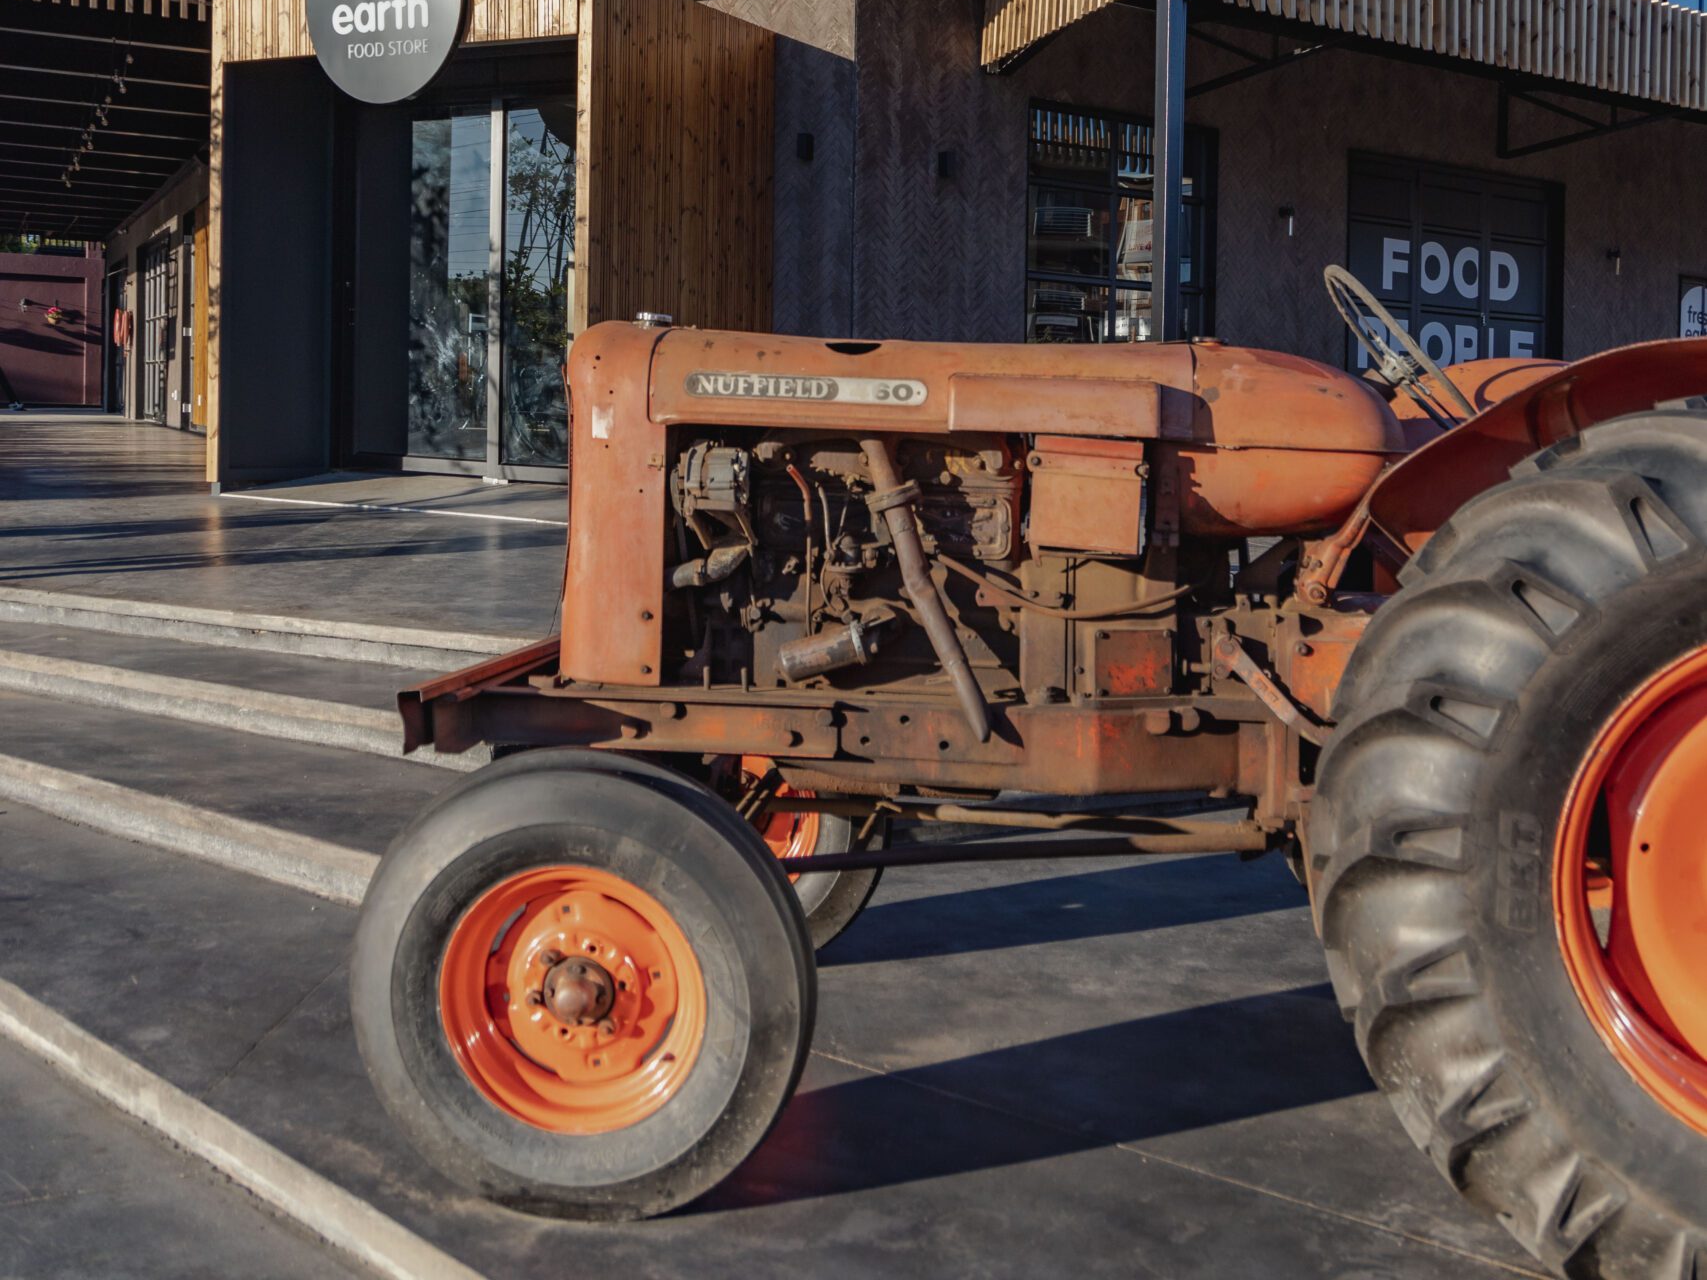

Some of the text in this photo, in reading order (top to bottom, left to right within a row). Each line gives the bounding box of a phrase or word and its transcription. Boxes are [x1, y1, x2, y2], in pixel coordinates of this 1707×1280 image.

[347, 39, 429, 59] FOOD STORE
[1382, 237, 1519, 302] FOOD
[697, 375, 829, 399] NUFFIELD
